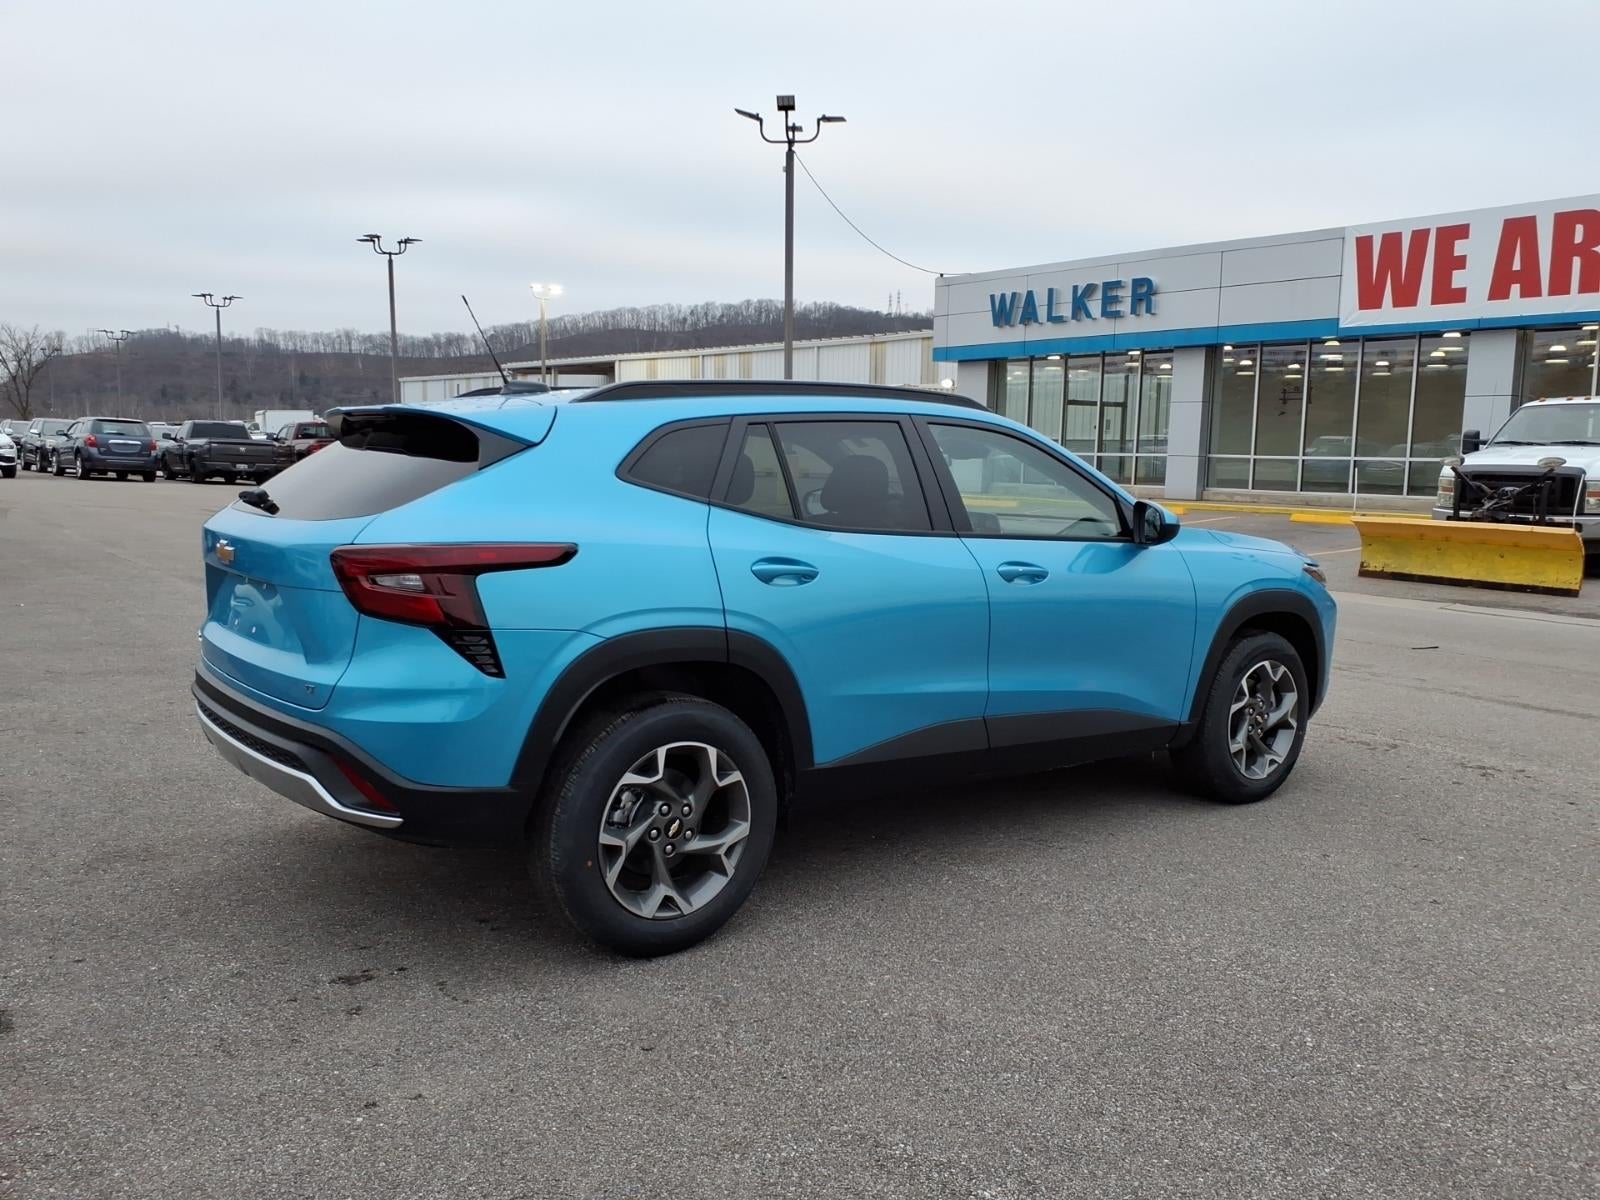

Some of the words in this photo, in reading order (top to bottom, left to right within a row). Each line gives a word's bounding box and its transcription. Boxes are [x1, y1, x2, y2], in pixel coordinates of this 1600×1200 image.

[1355, 223, 1470, 311] WE
[1487, 209, 1600, 301] AR
[989, 277, 1157, 327] WALKER
